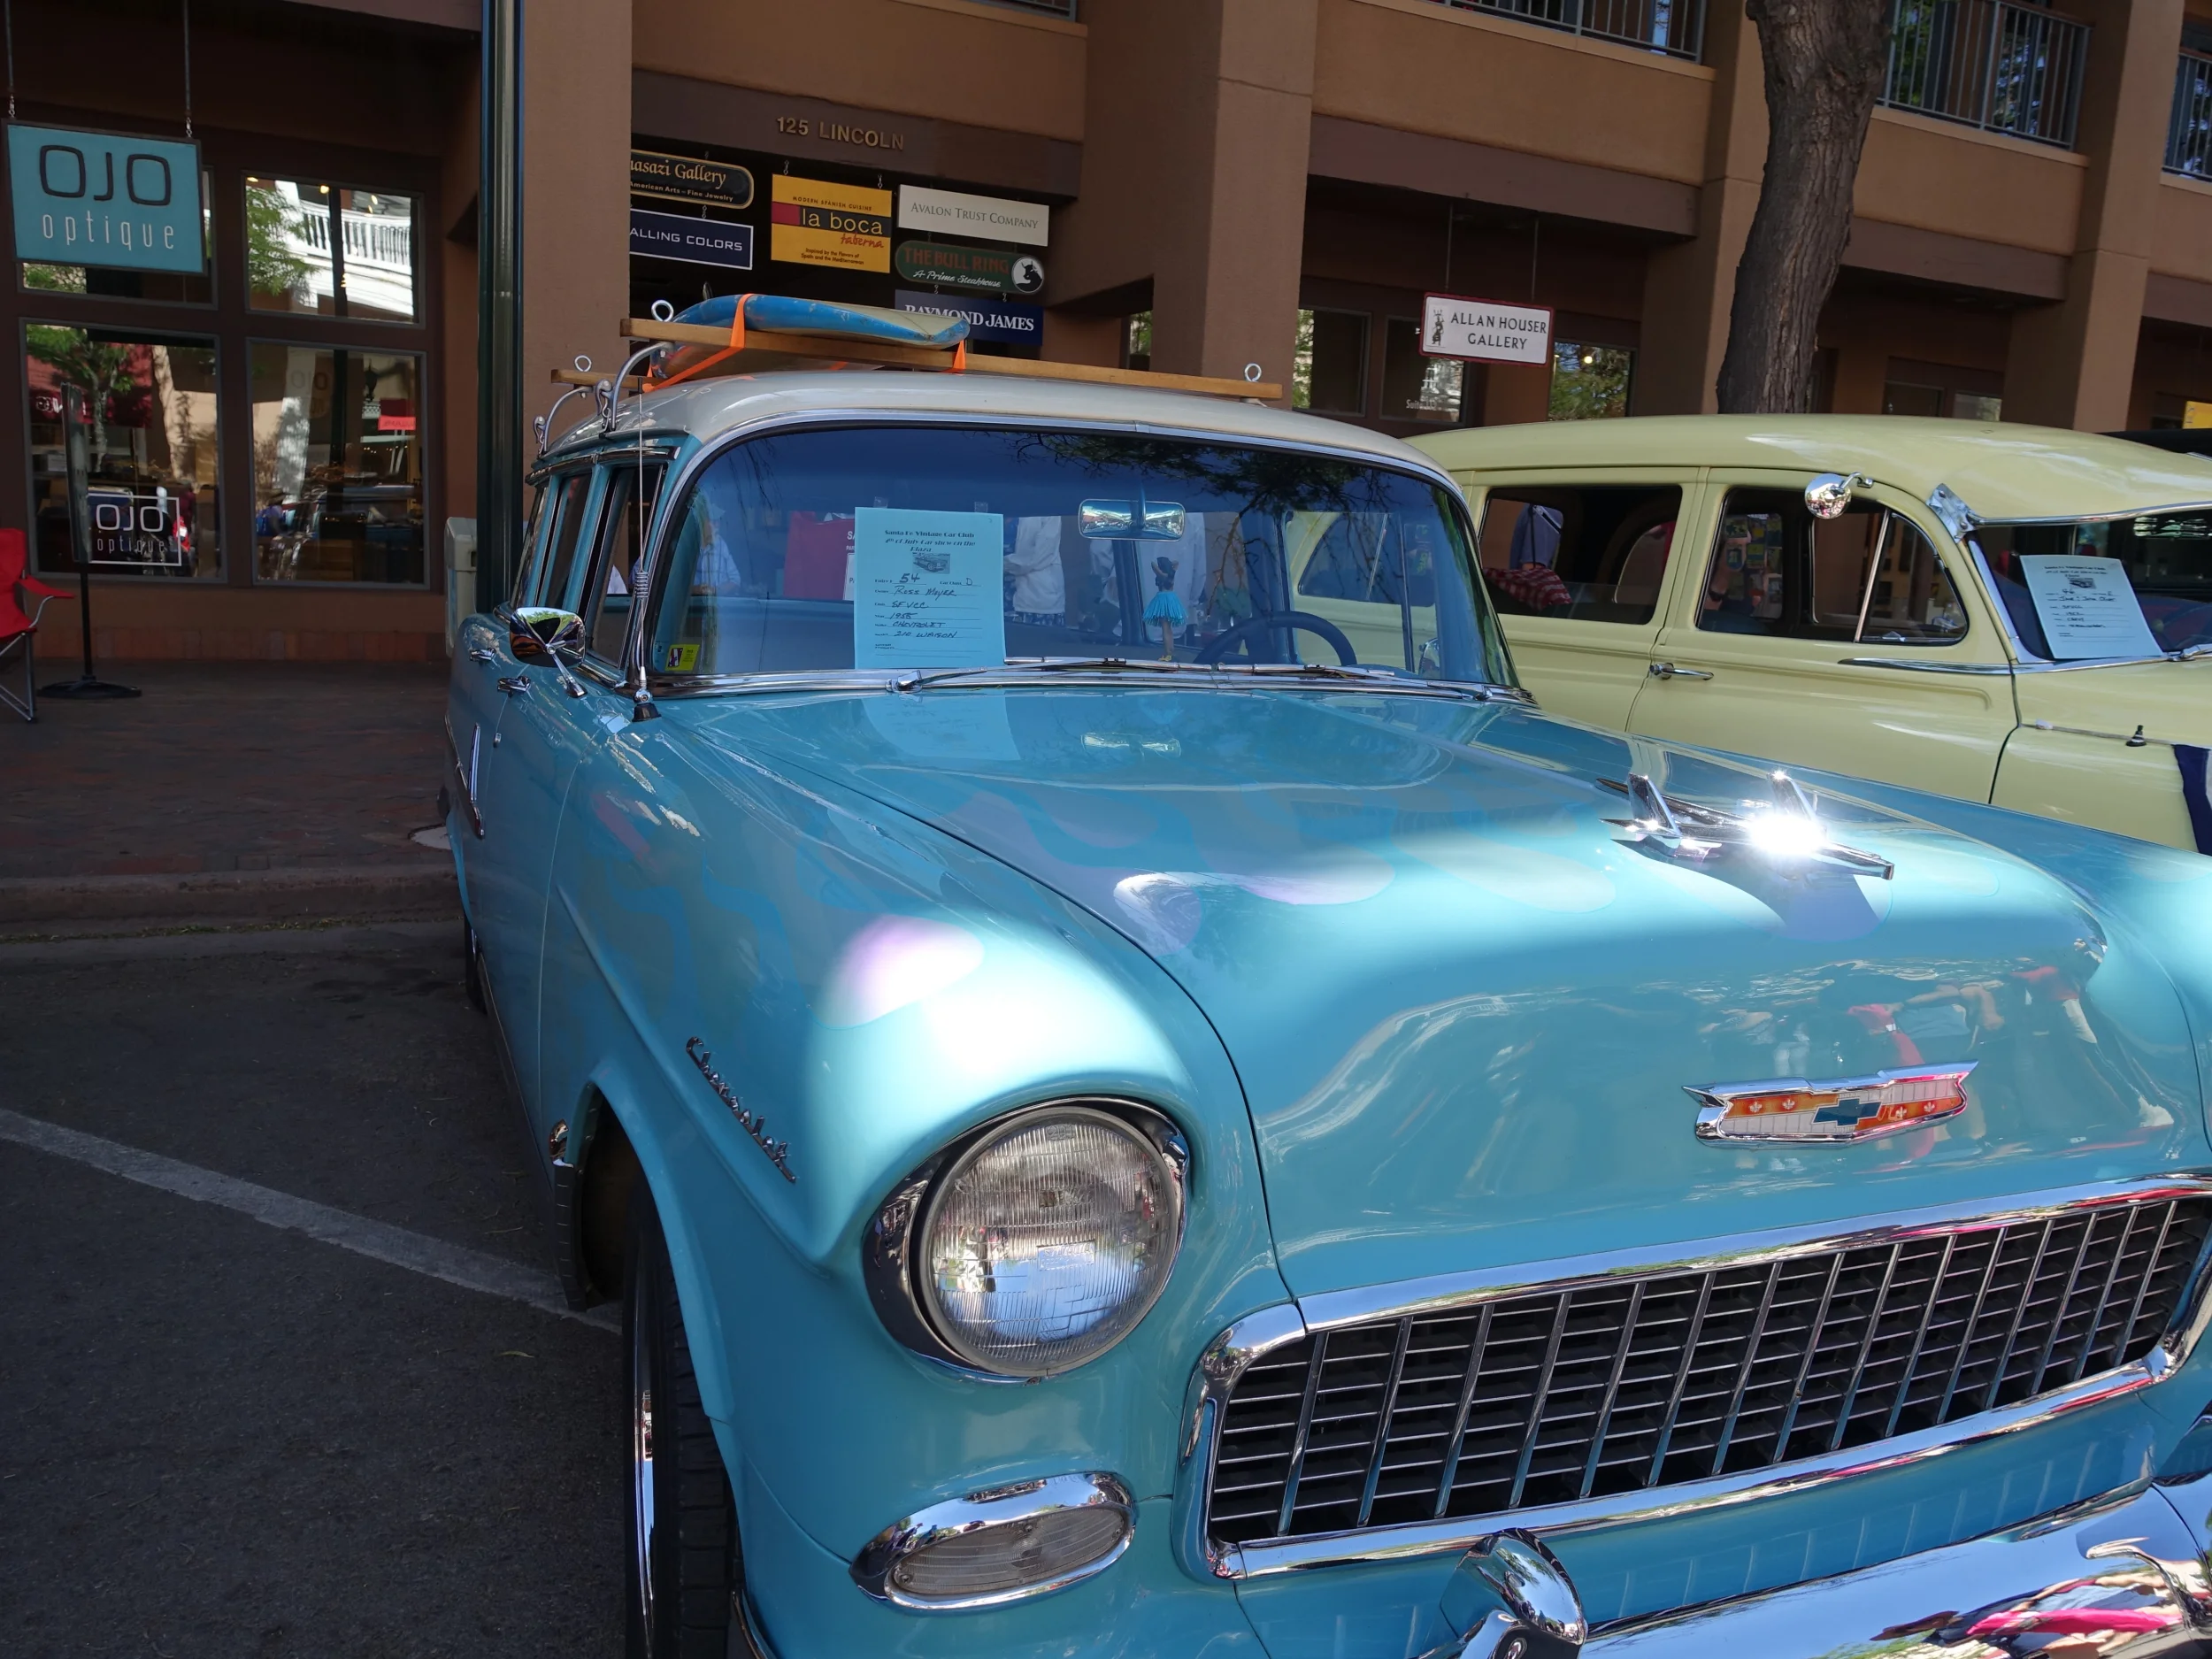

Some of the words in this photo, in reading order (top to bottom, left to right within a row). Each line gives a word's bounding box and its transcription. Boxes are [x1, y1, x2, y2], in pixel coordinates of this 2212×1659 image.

[776, 116, 809, 135] 125
[819, 121, 903, 150] LINCOLN
[39, 144, 172, 206] OJO
[674, 164, 726, 189] Gallery
[705, 192, 733, 202] Jewelry
[792, 196, 818, 204] MODERN
[821, 200, 846, 209] SPANISH
[803, 208, 820, 227] la
[830, 212, 883, 235] boca
[910, 202, 952, 217] AVALON
[955, 207, 987, 221] TRUST
[989, 212, 1039, 229] COMPANY
[42, 210, 174, 251] optique
[841, 232, 884, 249] taberna
[686, 235, 743, 251] COLORS
[904, 247, 932, 265] THE
[933, 251, 969, 270] BULL
[927, 271, 955, 282] Prime
[957, 274, 1001, 288] Steakhouse
[985, 314, 1034, 331] JAMES
[1450, 312, 1495, 328] ALLAN
[1499, 317, 1547, 334] HOUSER
[1468, 333, 1528, 350] GALLERY
[96, 504, 164, 532] OJO
[97, 535, 165, 555] optique
[899, 573, 920, 583] 54
